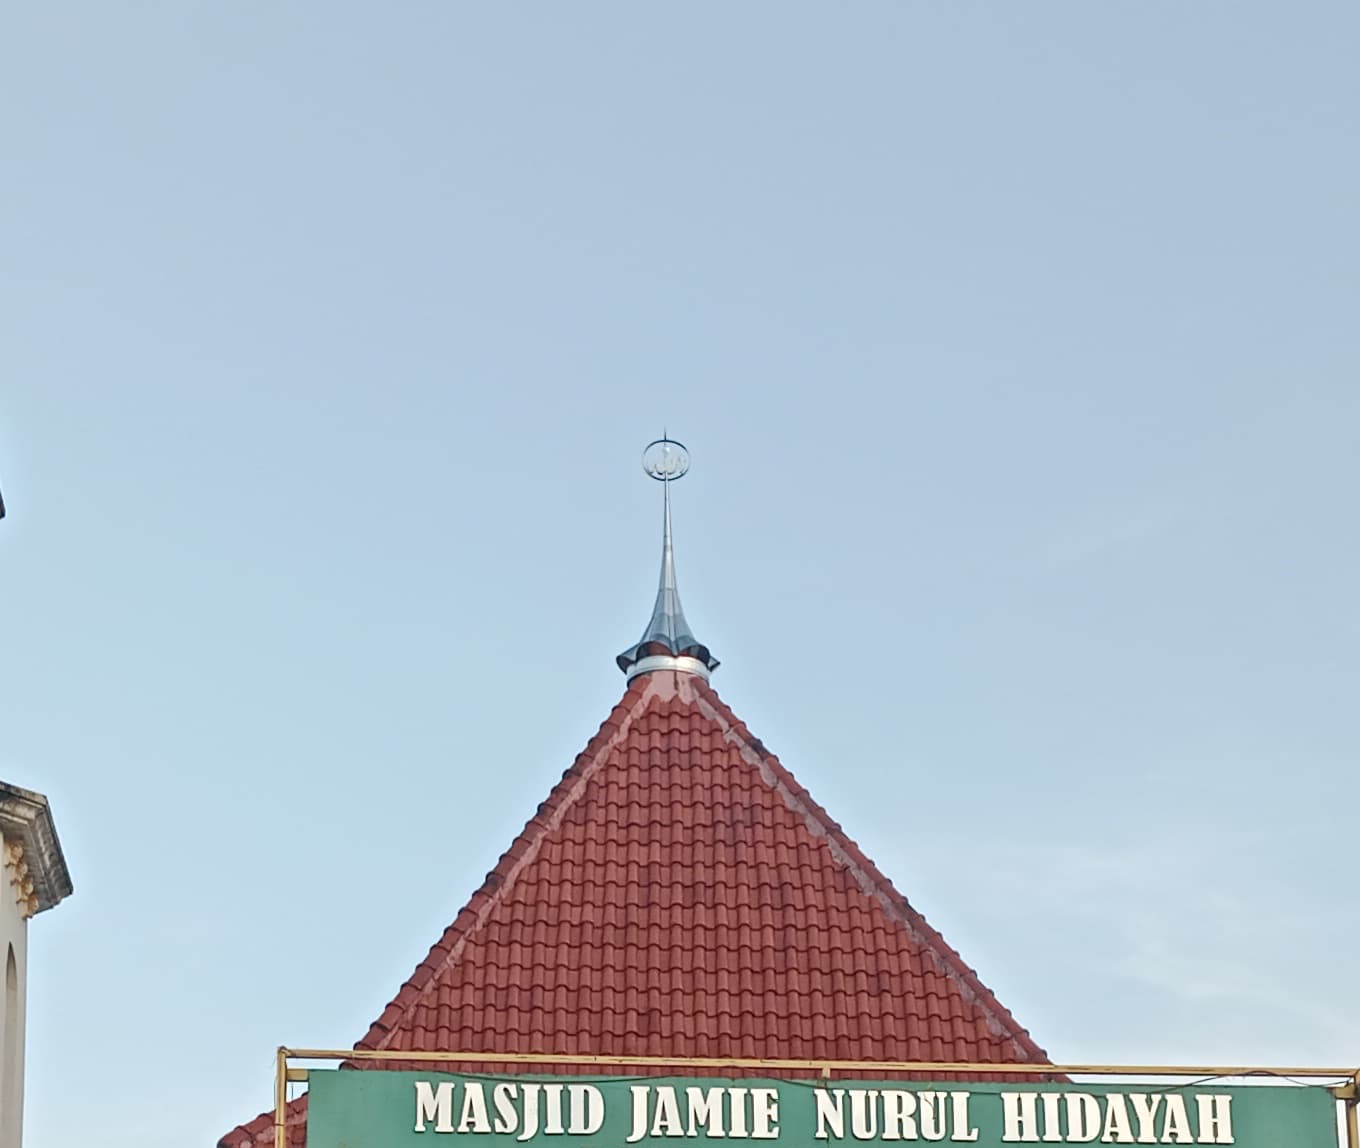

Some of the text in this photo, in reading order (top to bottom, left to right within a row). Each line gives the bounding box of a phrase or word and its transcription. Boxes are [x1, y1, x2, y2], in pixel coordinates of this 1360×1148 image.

[414, 1081, 1235, 1145] MASJID JAMIE NURUL HIDAYAH
